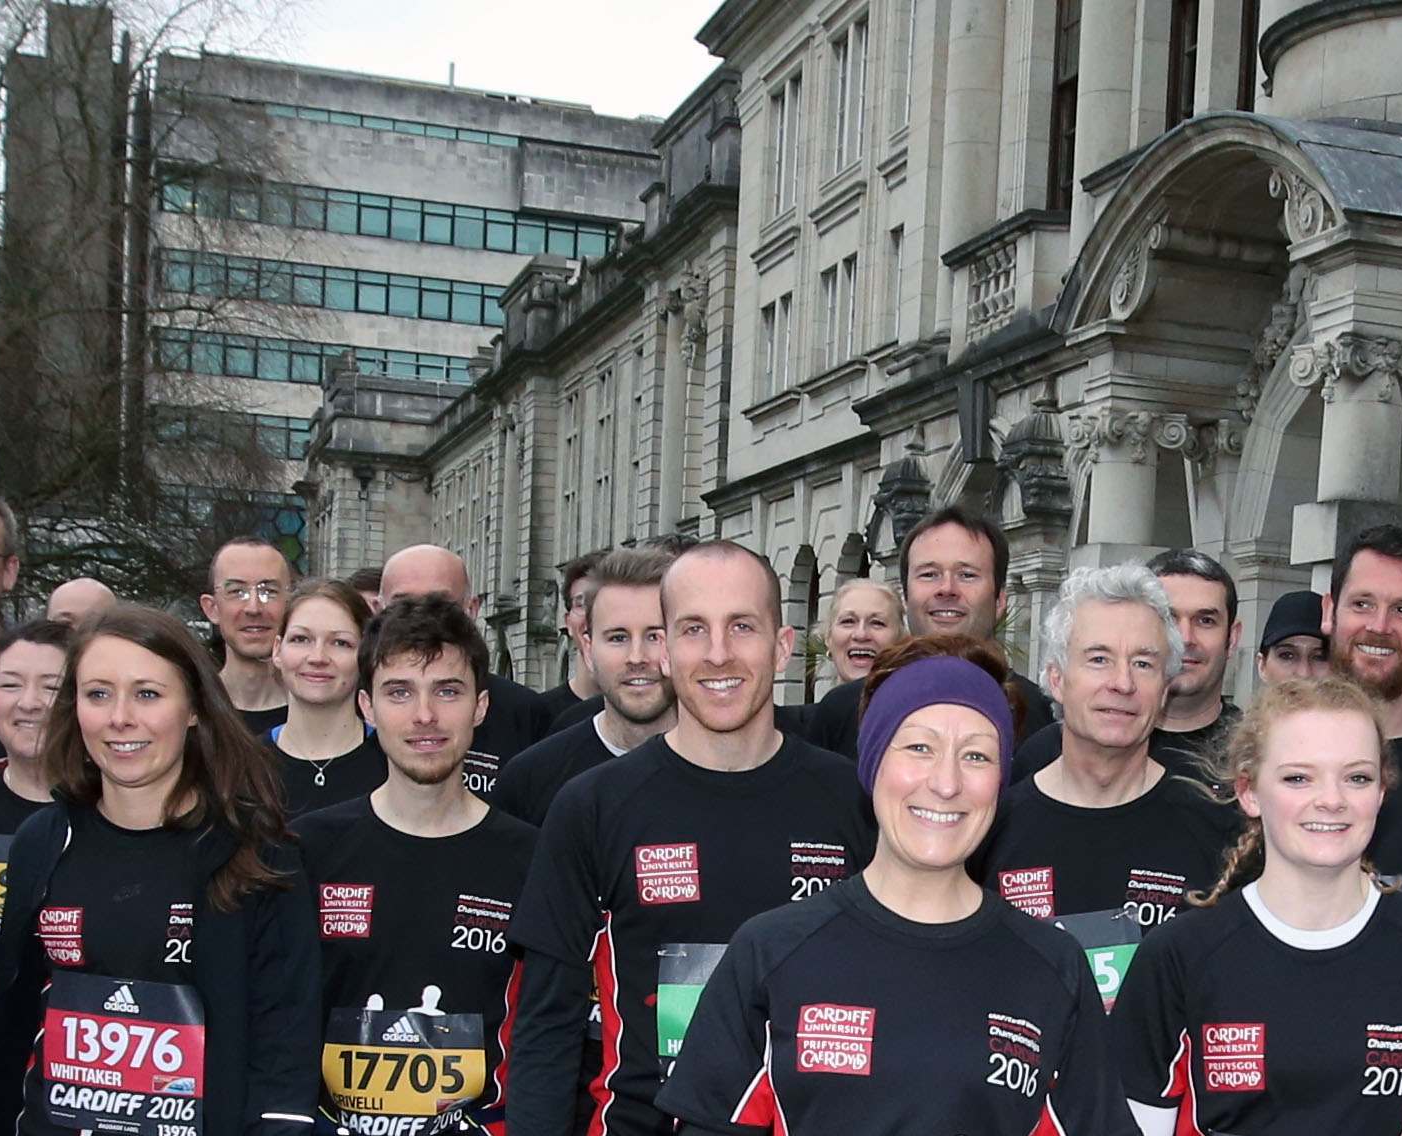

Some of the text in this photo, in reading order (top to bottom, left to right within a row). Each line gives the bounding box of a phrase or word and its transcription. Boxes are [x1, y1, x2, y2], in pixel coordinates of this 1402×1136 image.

[638, 846, 694, 863] CARDIFF
[641, 861, 693, 871] UNIVERSITY
[642, 876, 694, 887] PRIFYSGOL
[1002, 869, 1050, 887] CARDIFF
[323, 886, 372, 900] CARDIFF
[1004, 884, 1049, 895] UNIVERSITY
[450, 925, 507, 954] 2016
[1093, 951, 1120, 994] 5
[103, 1001, 140, 1014] adidas
[803, 1007, 871, 1025] CARDIFF
[382, 1033, 420, 1043] adidas
[804, 1023, 868, 1036] UNIVERSITY
[1206, 1027, 1261, 1044] CARDIFF
[62, 1016, 184, 1073] 13976
[803, 1040, 865, 1053] PRIFYSGOL
[1207, 1044, 1259, 1053] UNIVERSITY
[50, 1062, 123, 1087] WHITTAKER
[338, 1050, 465, 1094] 17705
[986, 1053, 1040, 1098] 2016
[49, 1083, 196, 1121] CARDIFF 2016
